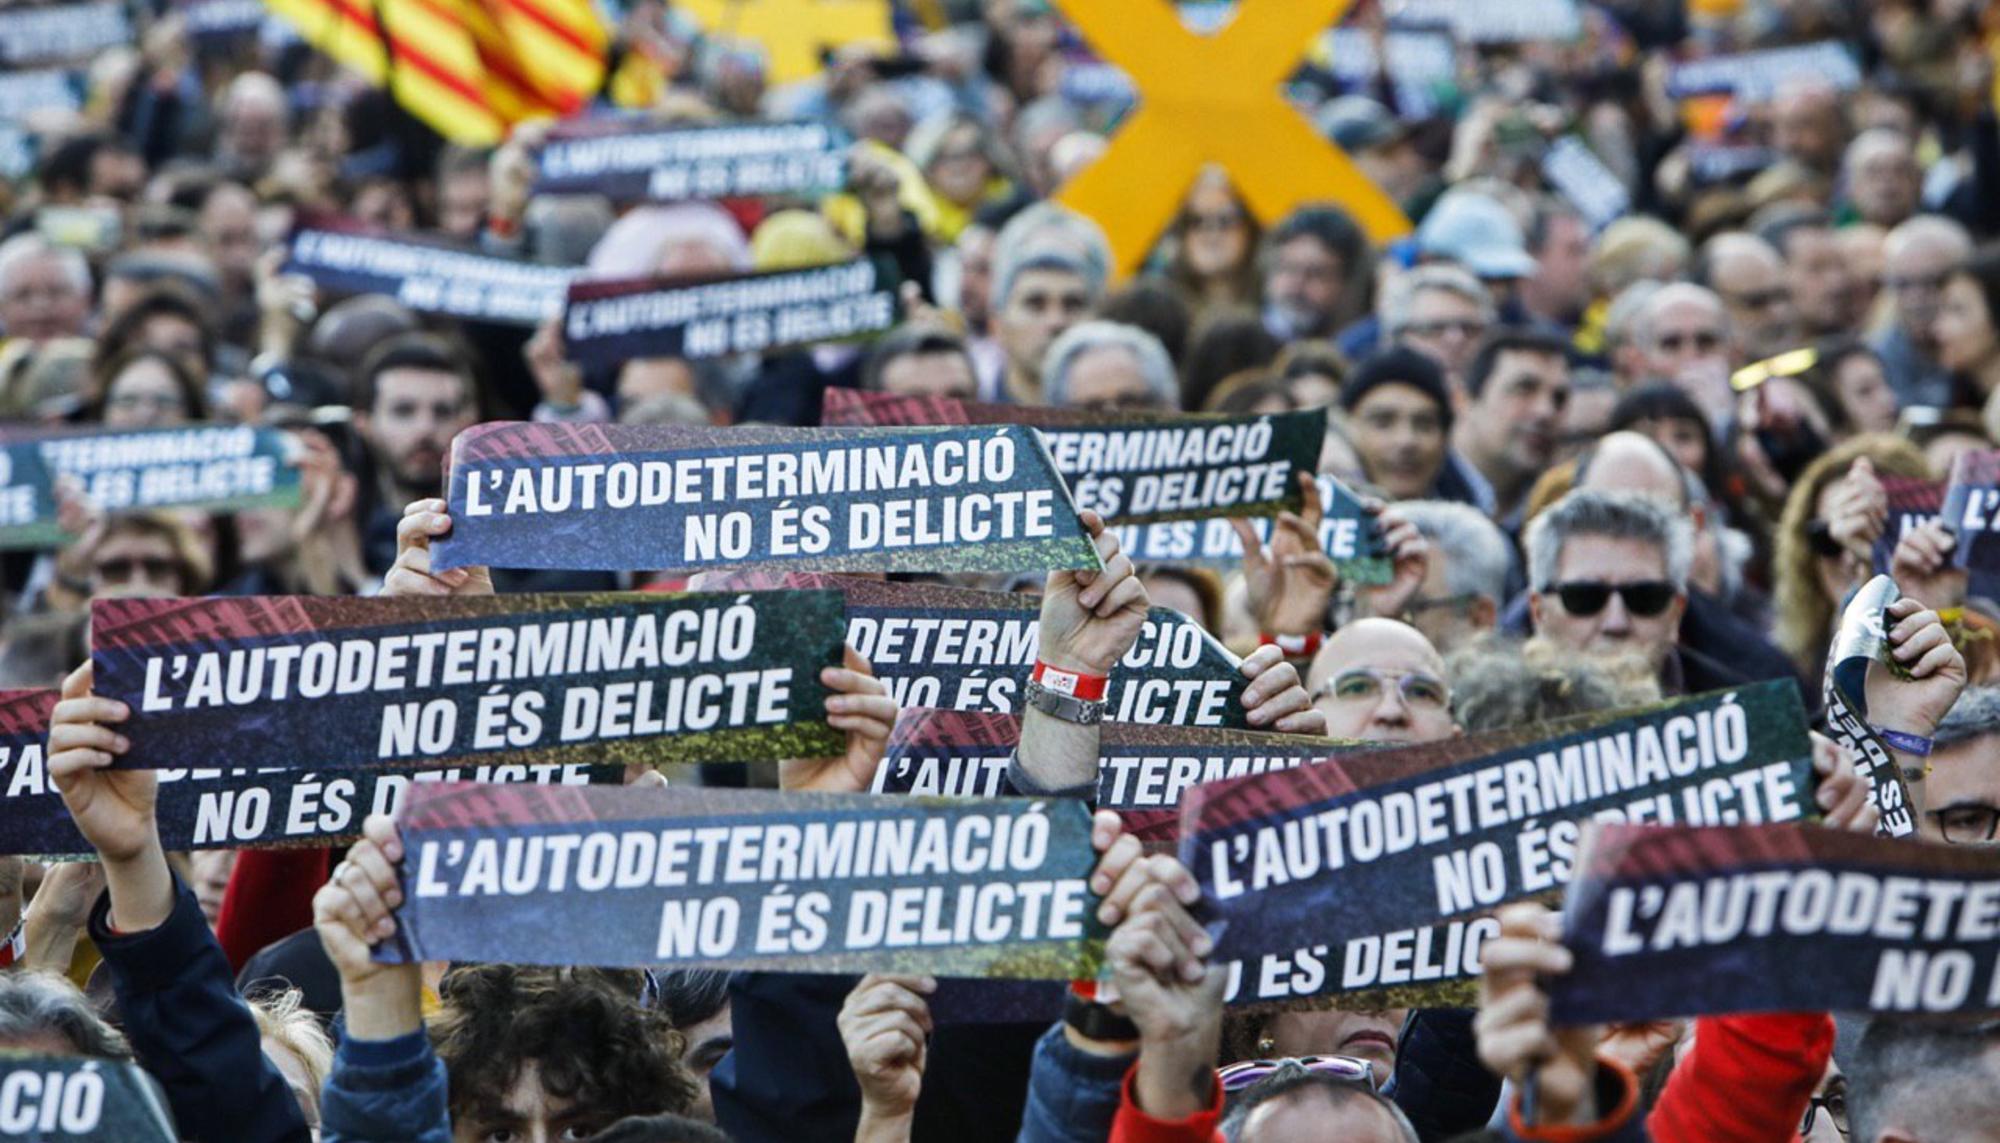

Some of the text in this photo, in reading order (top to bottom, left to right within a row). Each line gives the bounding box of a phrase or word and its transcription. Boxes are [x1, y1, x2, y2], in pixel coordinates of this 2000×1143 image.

[466, 428, 1015, 516] L'AUTODETERMINACIÓ
[1074, 472, 1125, 519] ÉS
[1130, 460, 1291, 515] DELICTE
[684, 489, 1053, 561] NO ÉS DELICTE
[142, 595, 756, 712] L'AUTODETERMINACIÓ
[378, 668, 793, 757] NO ÉS DELICTE
[193, 786, 271, 844] NO
[284, 773, 356, 834] ÉS
[1211, 692, 1748, 900] L'AUTODETERMINACIÓ
[415, 802, 1049, 897] L'AUTODETERMINACIÓ
[1433, 842, 1507, 916] NO
[1516, 819, 1579, 892] ÉS
[657, 879, 1086, 959] NO ÉS DELICTE
[1342, 918, 1500, 989] DELIC
[1869, 949, 1975, 1012] NO
